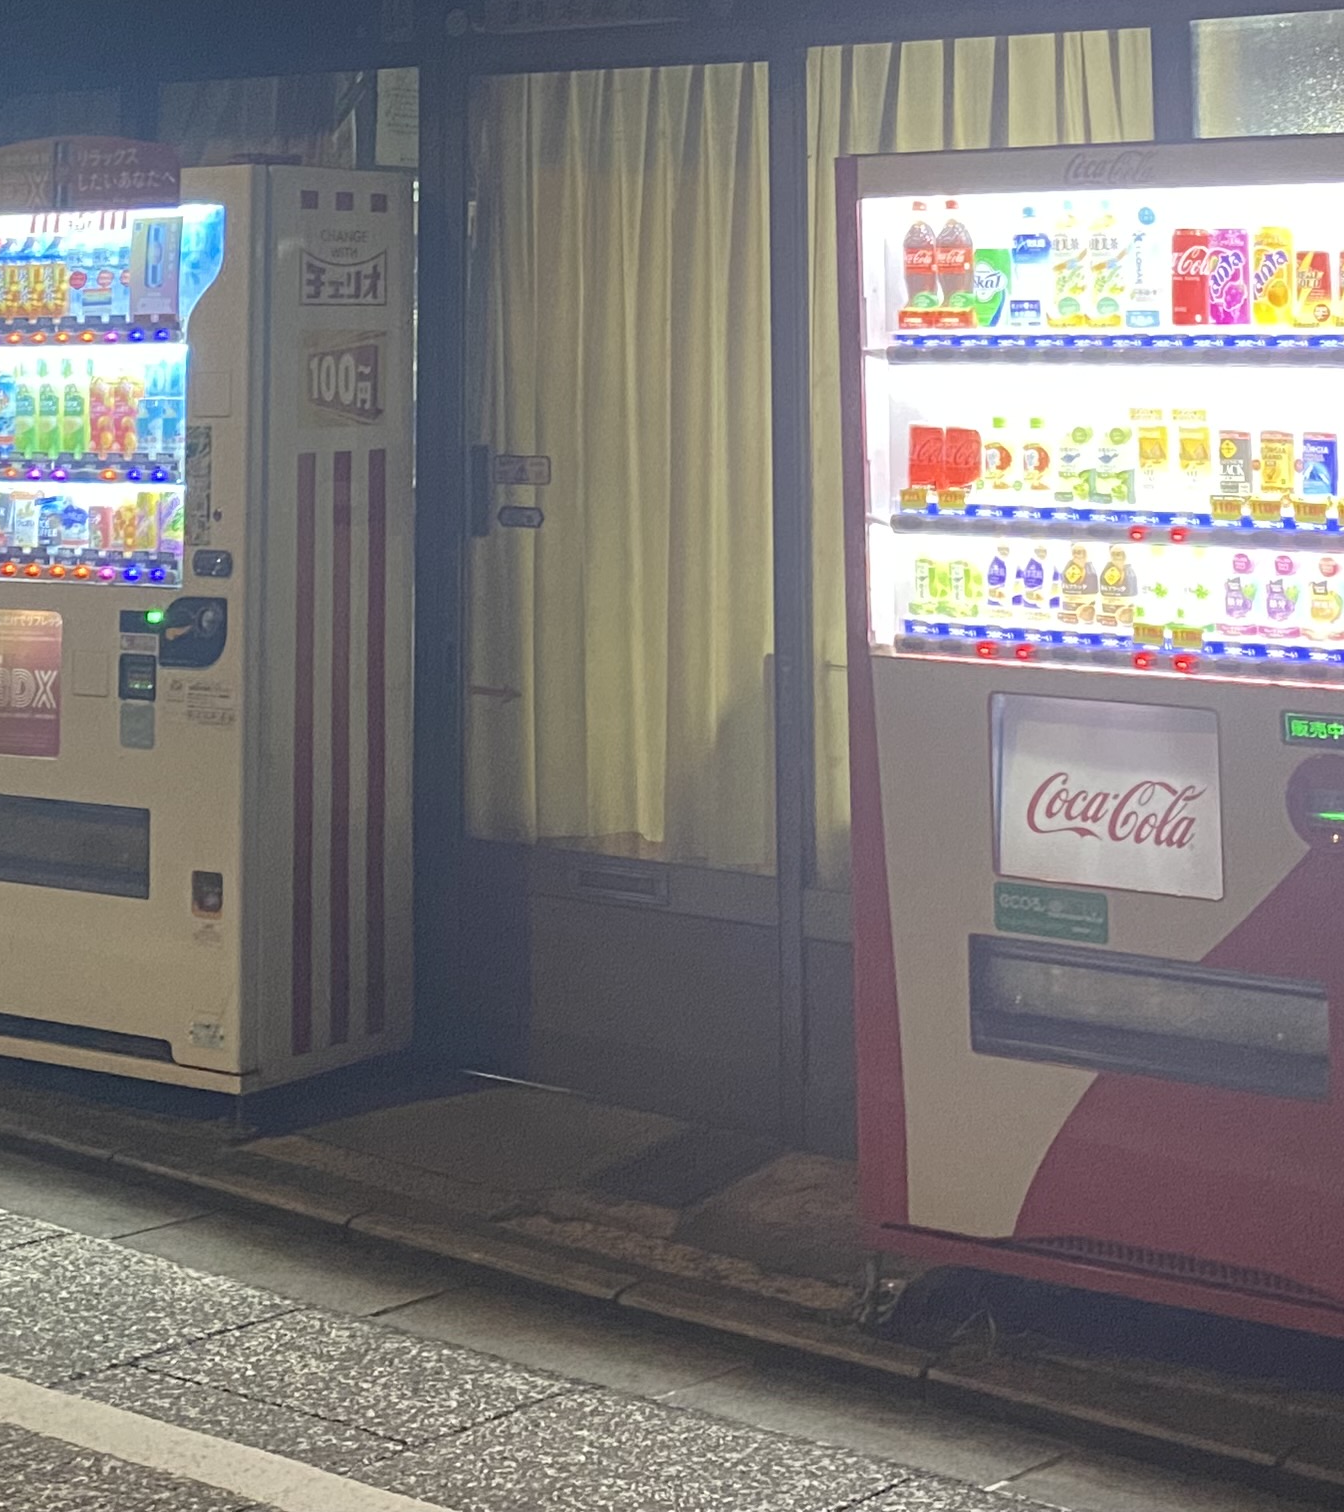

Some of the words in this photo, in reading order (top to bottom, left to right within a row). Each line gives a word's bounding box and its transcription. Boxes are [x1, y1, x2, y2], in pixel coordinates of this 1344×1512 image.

[77, 148, 139, 167] リラックス
[77, 169, 176, 192] したいあなたへ
[319, 229, 368, 243] CHANGE
[306, 261, 381, 300] チェリオ
[1209, 251, 1243, 296] anta
[1253, 249, 1289, 301] anta
[1290, 719, 1344, 740] 販売中
[1027, 772, 1207, 850] Coca-Cola
